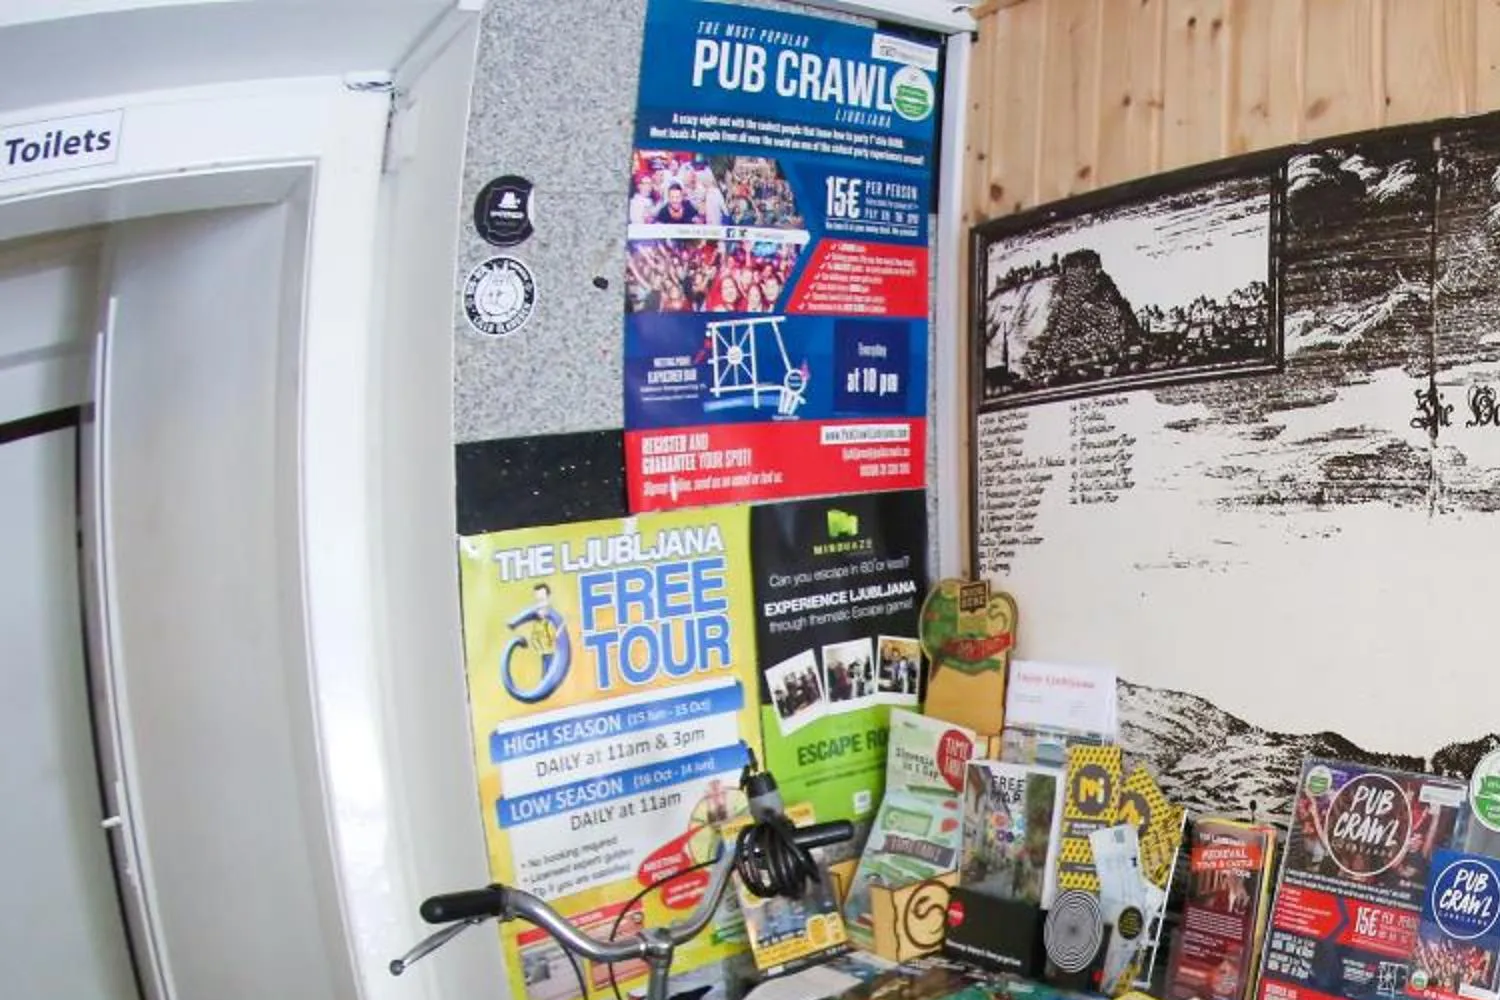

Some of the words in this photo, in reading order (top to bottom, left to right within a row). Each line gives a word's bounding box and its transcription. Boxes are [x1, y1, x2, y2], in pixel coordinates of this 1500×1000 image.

[698, 21, 718, 34] THE
[760, 29, 809, 48] POPULAR
[692, 39, 767, 93] PUB
[775, 50, 893, 111] CRAWL
[5, 130, 111, 165] Toilets
[825, 175, 862, 219] 15€
[865, 180, 881, 195] PER
[886, 183, 918, 200] PERSON
[847, 368, 859, 392] at
[863, 367, 877, 392] 10
[880, 373, 899, 397] pm
[642, 435, 687, 455] REGISTER
[689, 432, 709, 450] AND
[642, 453, 697, 475] GUARANTEE
[698, 450, 723, 470] YOUR
[496, 550, 556, 583] THE
[561, 525, 724, 575] LJUBLJANA
[769, 573, 793, 588] Can
[794, 571, 813, 586] you
[814, 566, 849, 582] escape
[850, 562, 859, 575] in
[579, 557, 728, 631] FREE
[764, 590, 848, 617] EXPERIENCE
[849, 580, 917, 602] LJUBLJANA
[769, 616, 809, 633] through
[809, 609, 850, 625] thematic
[851, 603, 884, 620] Escape
[582, 614, 732, 690] TOUR
[503, 731, 549, 757] HIGH
[552, 714, 622, 745] SEASON
[797, 733, 864, 766] ESCAPE
[535, 751, 581, 778] DAILY
[586, 750, 603, 765] at
[608, 739, 652, 761] 11am
[655, 732, 669, 749] &
[673, 728, 706, 751] 3pm
[511, 795, 551, 822] LOW
[553, 776, 624, 809] SEASON
[991, 774, 1025, 792] FREE
[1349, 785, 1395, 815] PUB
[570, 804, 615, 831] DAILY
[619, 802, 636, 818] at
[640, 792, 682, 814] 11am
[1333, 811, 1400, 847] CRAWL
[1453, 868, 1489, 893] PUB
[1439, 888, 1493, 918] CRAWL
